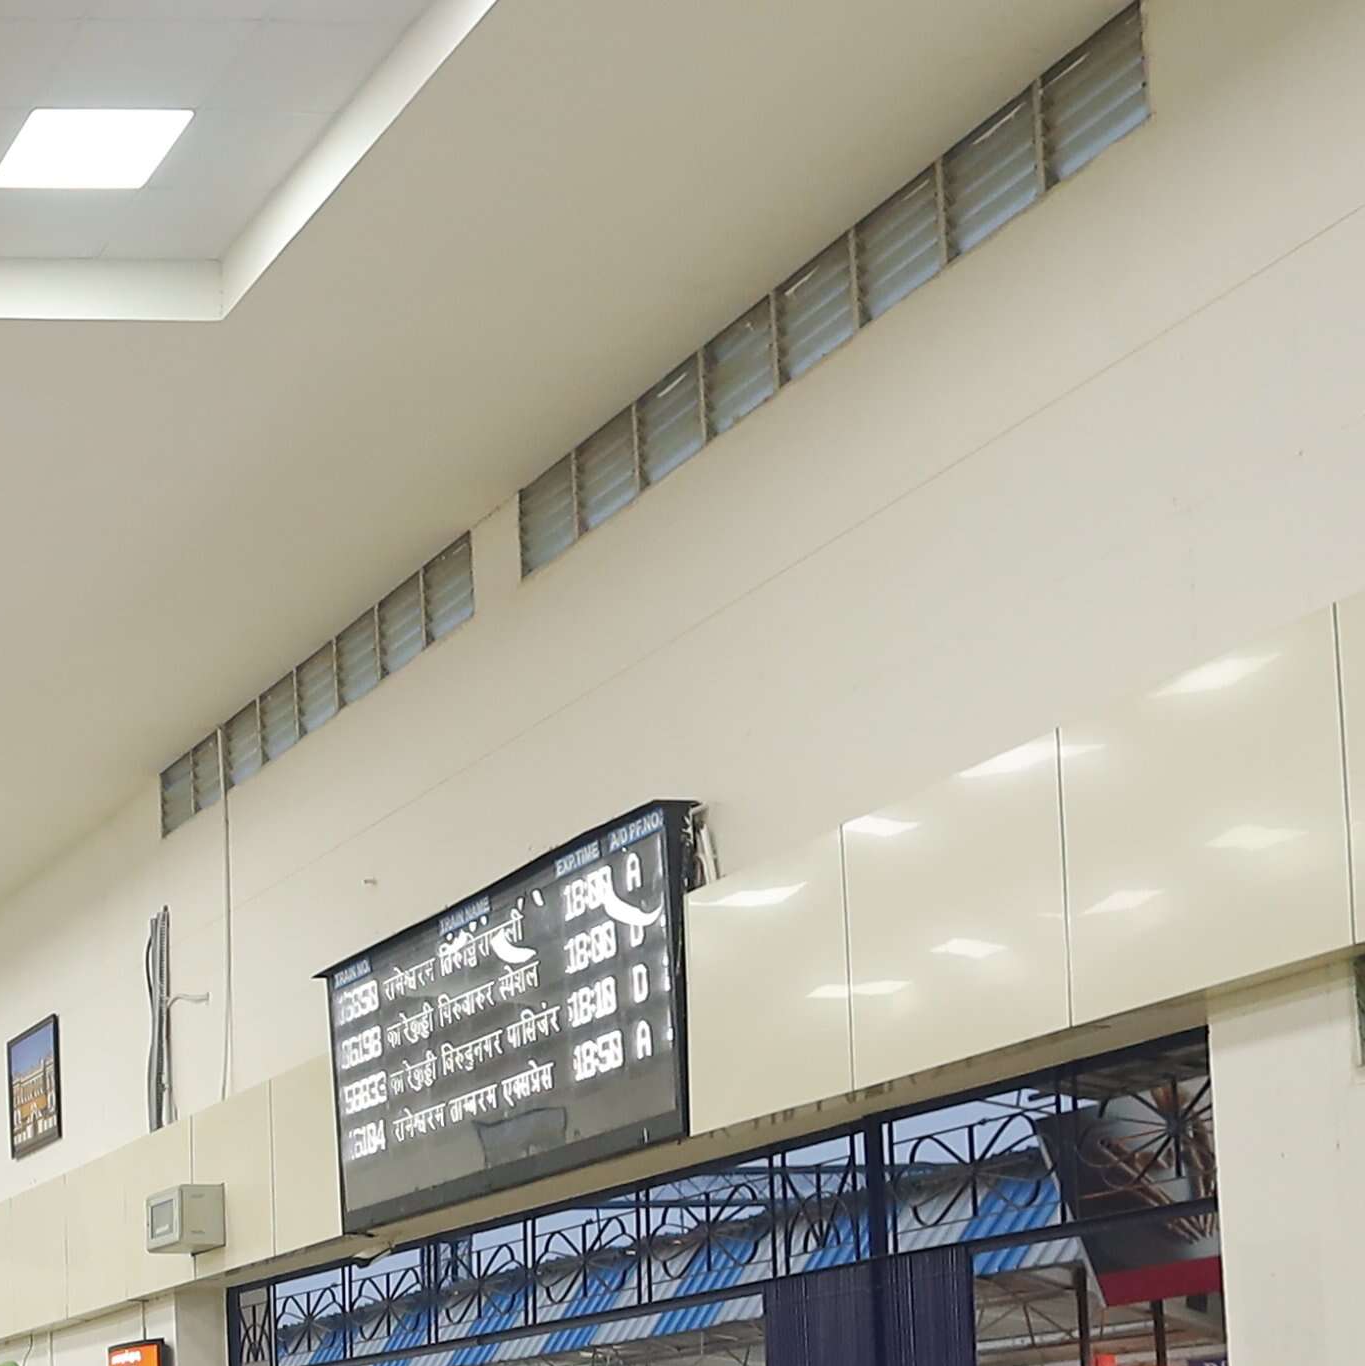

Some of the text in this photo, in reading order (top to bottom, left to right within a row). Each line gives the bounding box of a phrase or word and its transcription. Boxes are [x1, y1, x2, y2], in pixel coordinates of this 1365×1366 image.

[626, 852, 641, 892] A
[564, 920, 617, 974] 18:00
[568, 976, 617, 1028] 18:10
[632, 963, 649, 1003] D
[636, 1020, 652, 1060] A
